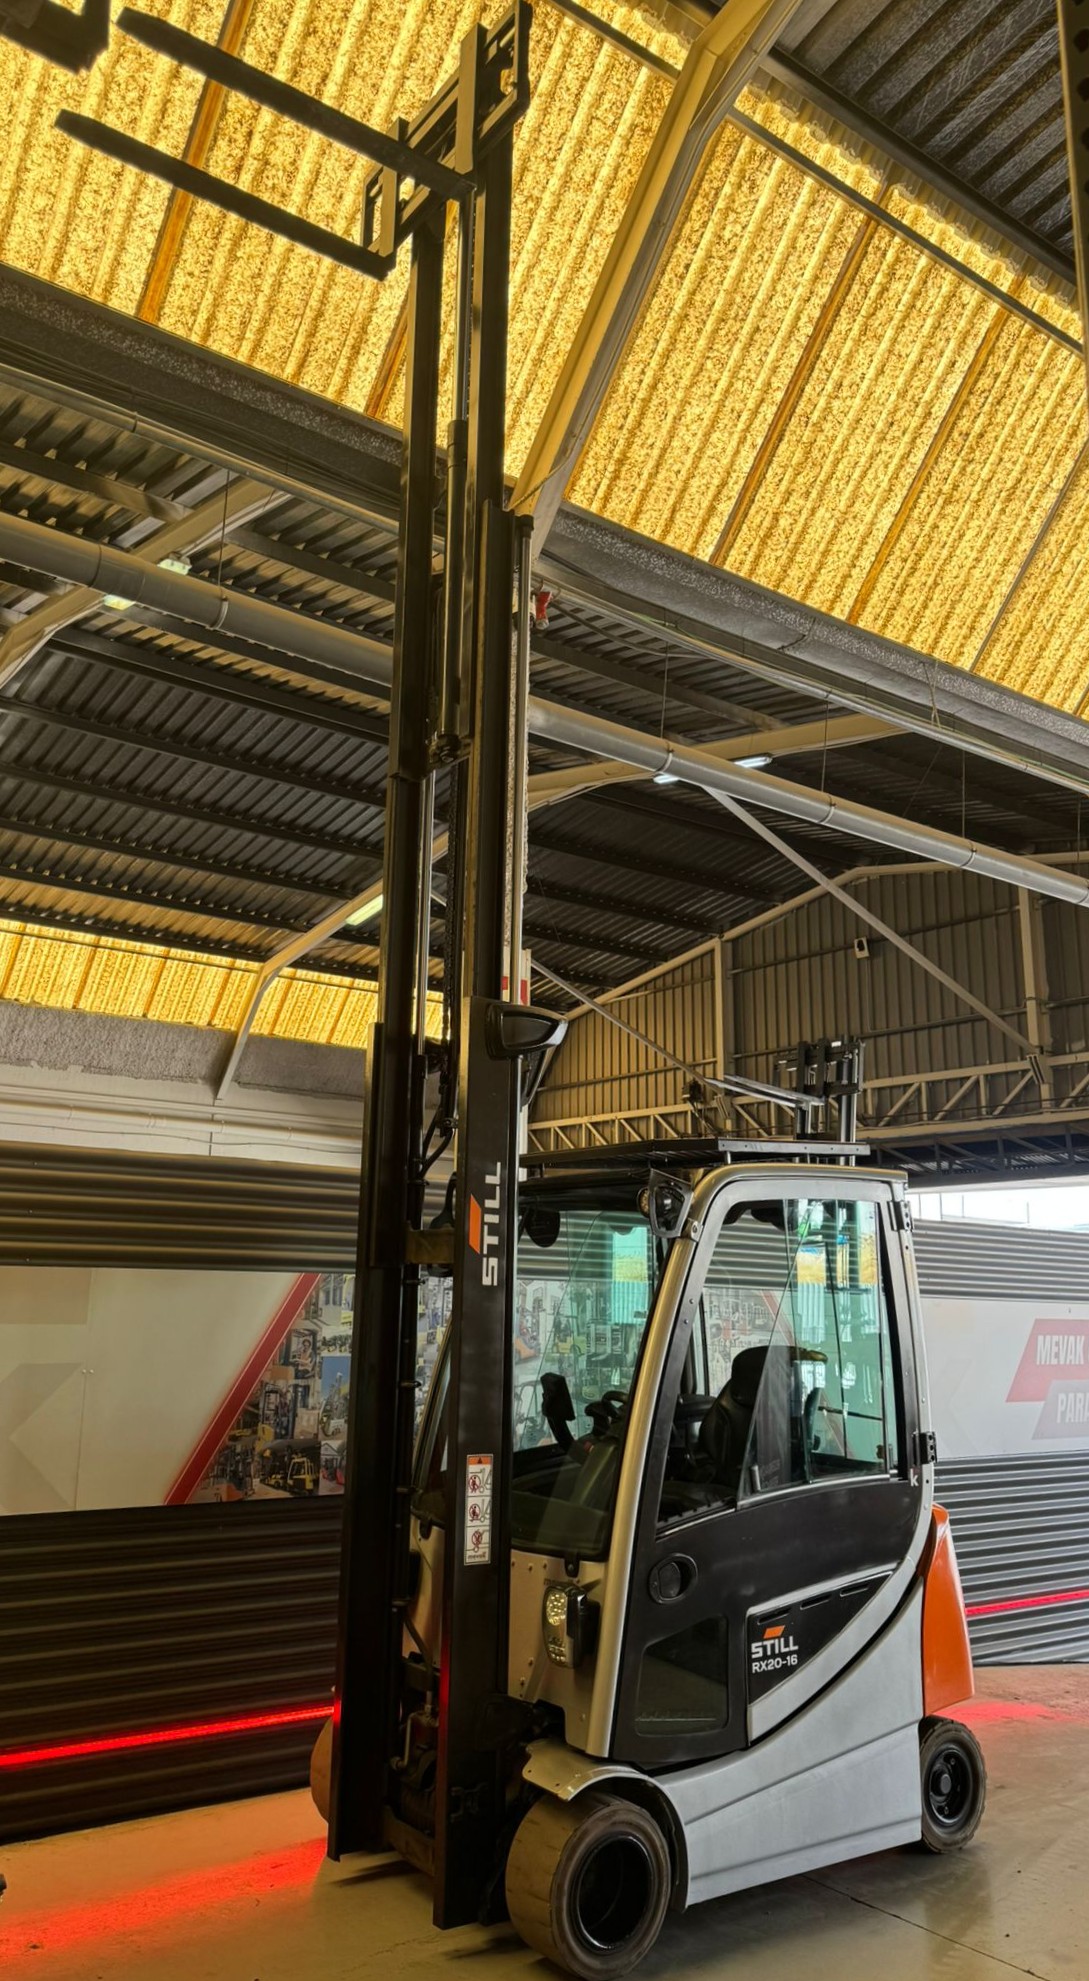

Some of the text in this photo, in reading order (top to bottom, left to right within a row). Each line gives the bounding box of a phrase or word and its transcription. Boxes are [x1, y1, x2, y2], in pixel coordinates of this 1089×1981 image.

[482, 1161, 502, 1287] STILL
[1036, 1335, 1085, 1366] MEVAK
[751, 1635, 799, 1659] STILL
[751, 1654, 798, 1674] RX20-16
